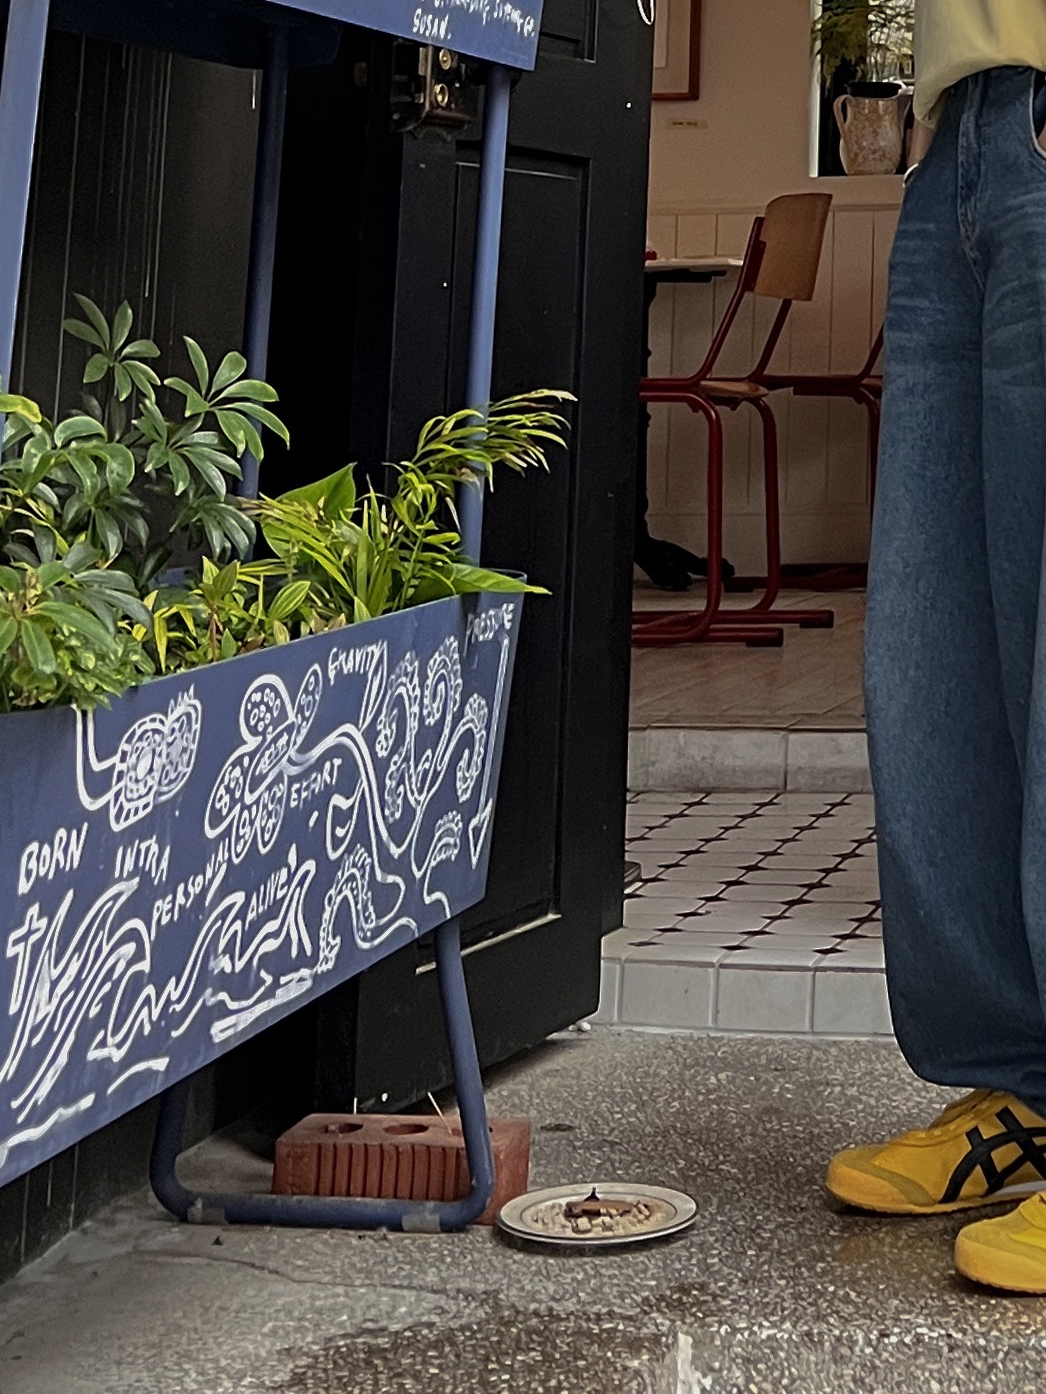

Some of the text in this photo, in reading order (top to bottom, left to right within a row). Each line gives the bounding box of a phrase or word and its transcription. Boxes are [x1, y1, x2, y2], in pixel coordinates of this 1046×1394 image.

[17, 822, 89, 896] BORN
[114, 834, 171, 887] INTRA
[150, 837, 230, 941] PERSONAL
